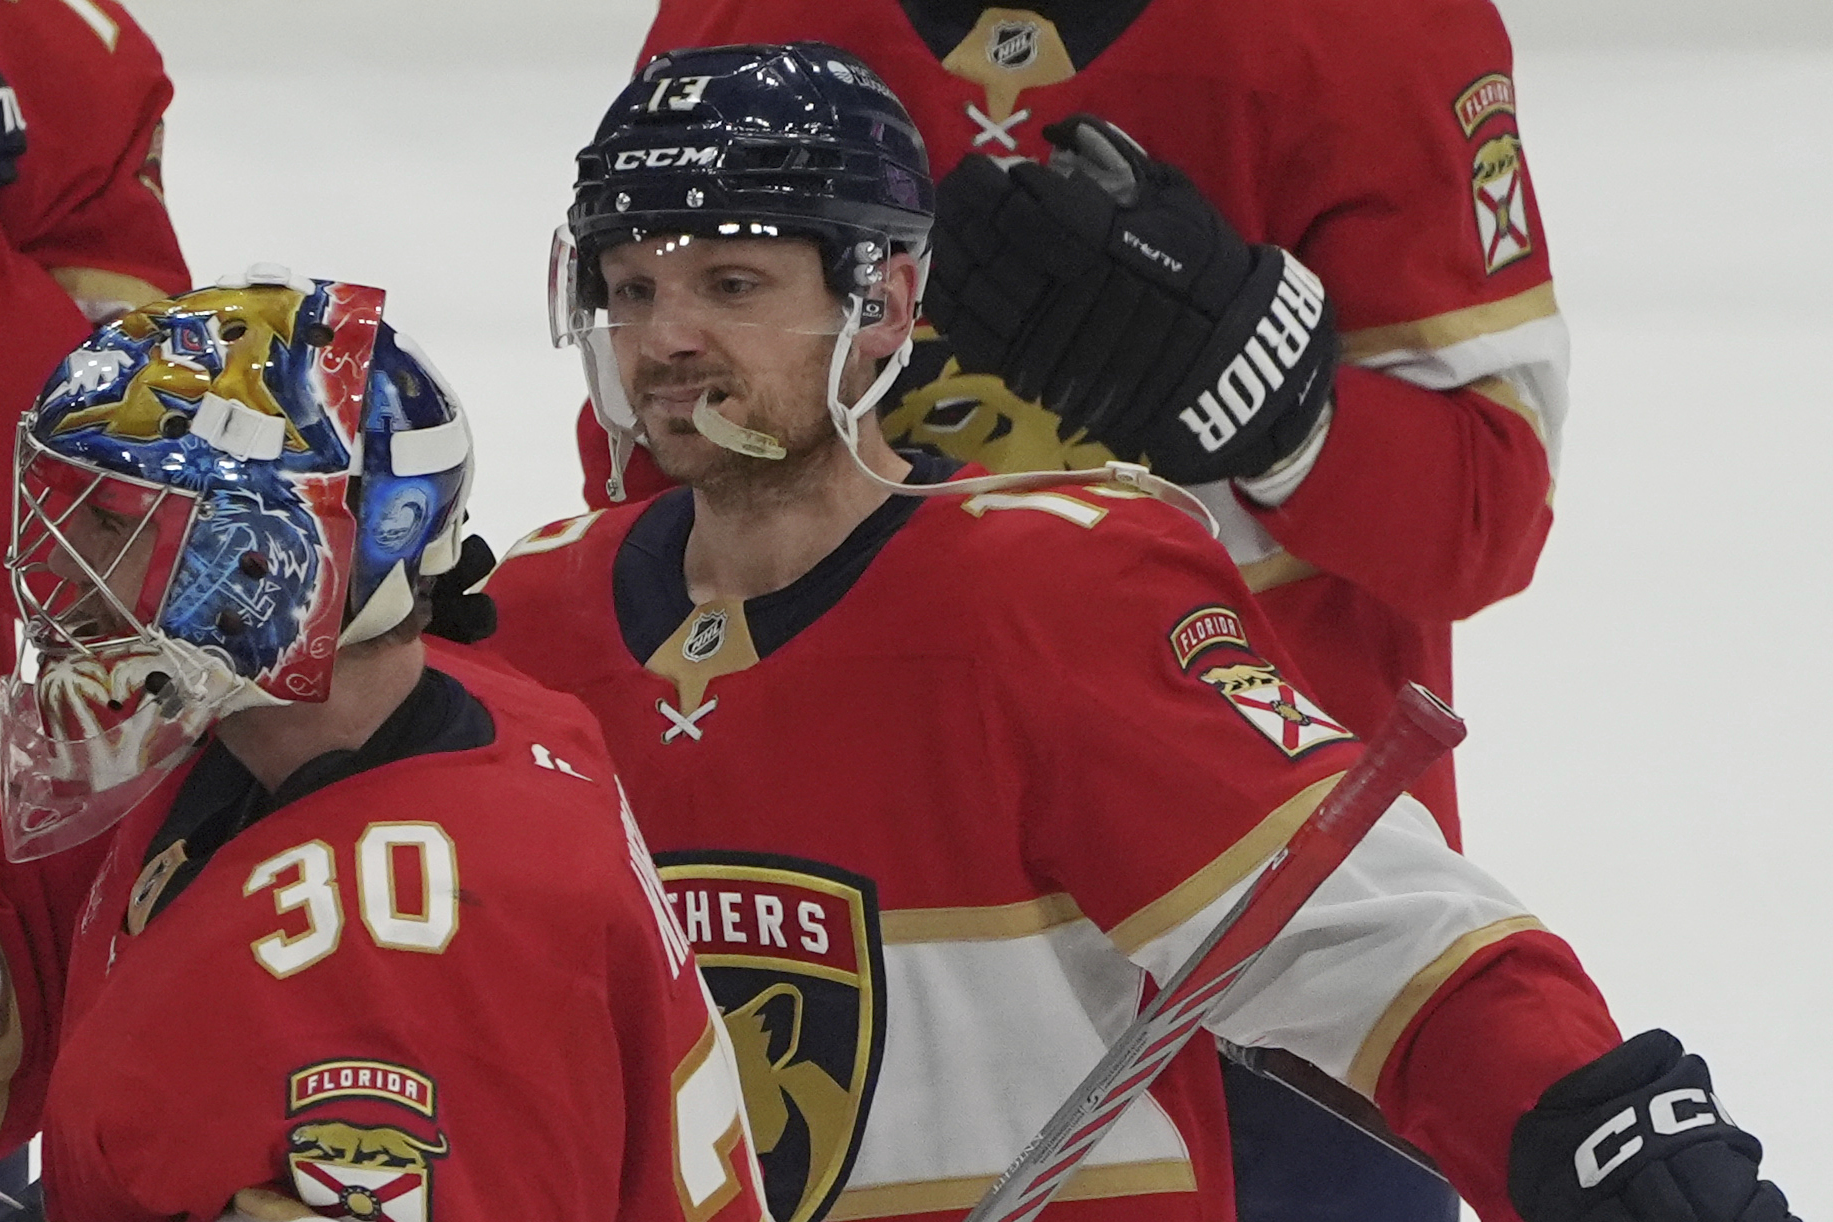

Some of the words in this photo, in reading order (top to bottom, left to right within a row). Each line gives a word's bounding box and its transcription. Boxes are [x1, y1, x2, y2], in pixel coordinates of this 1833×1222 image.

[647, 75, 713, 113] 13
[614, 146, 718, 171] CCM
[1180, 616, 1237, 652] FLORIDA
[242, 820, 460, 981] 30
[307, 1068, 418, 1100] FLORIDA
[1574, 1088, 1740, 1189] CC
